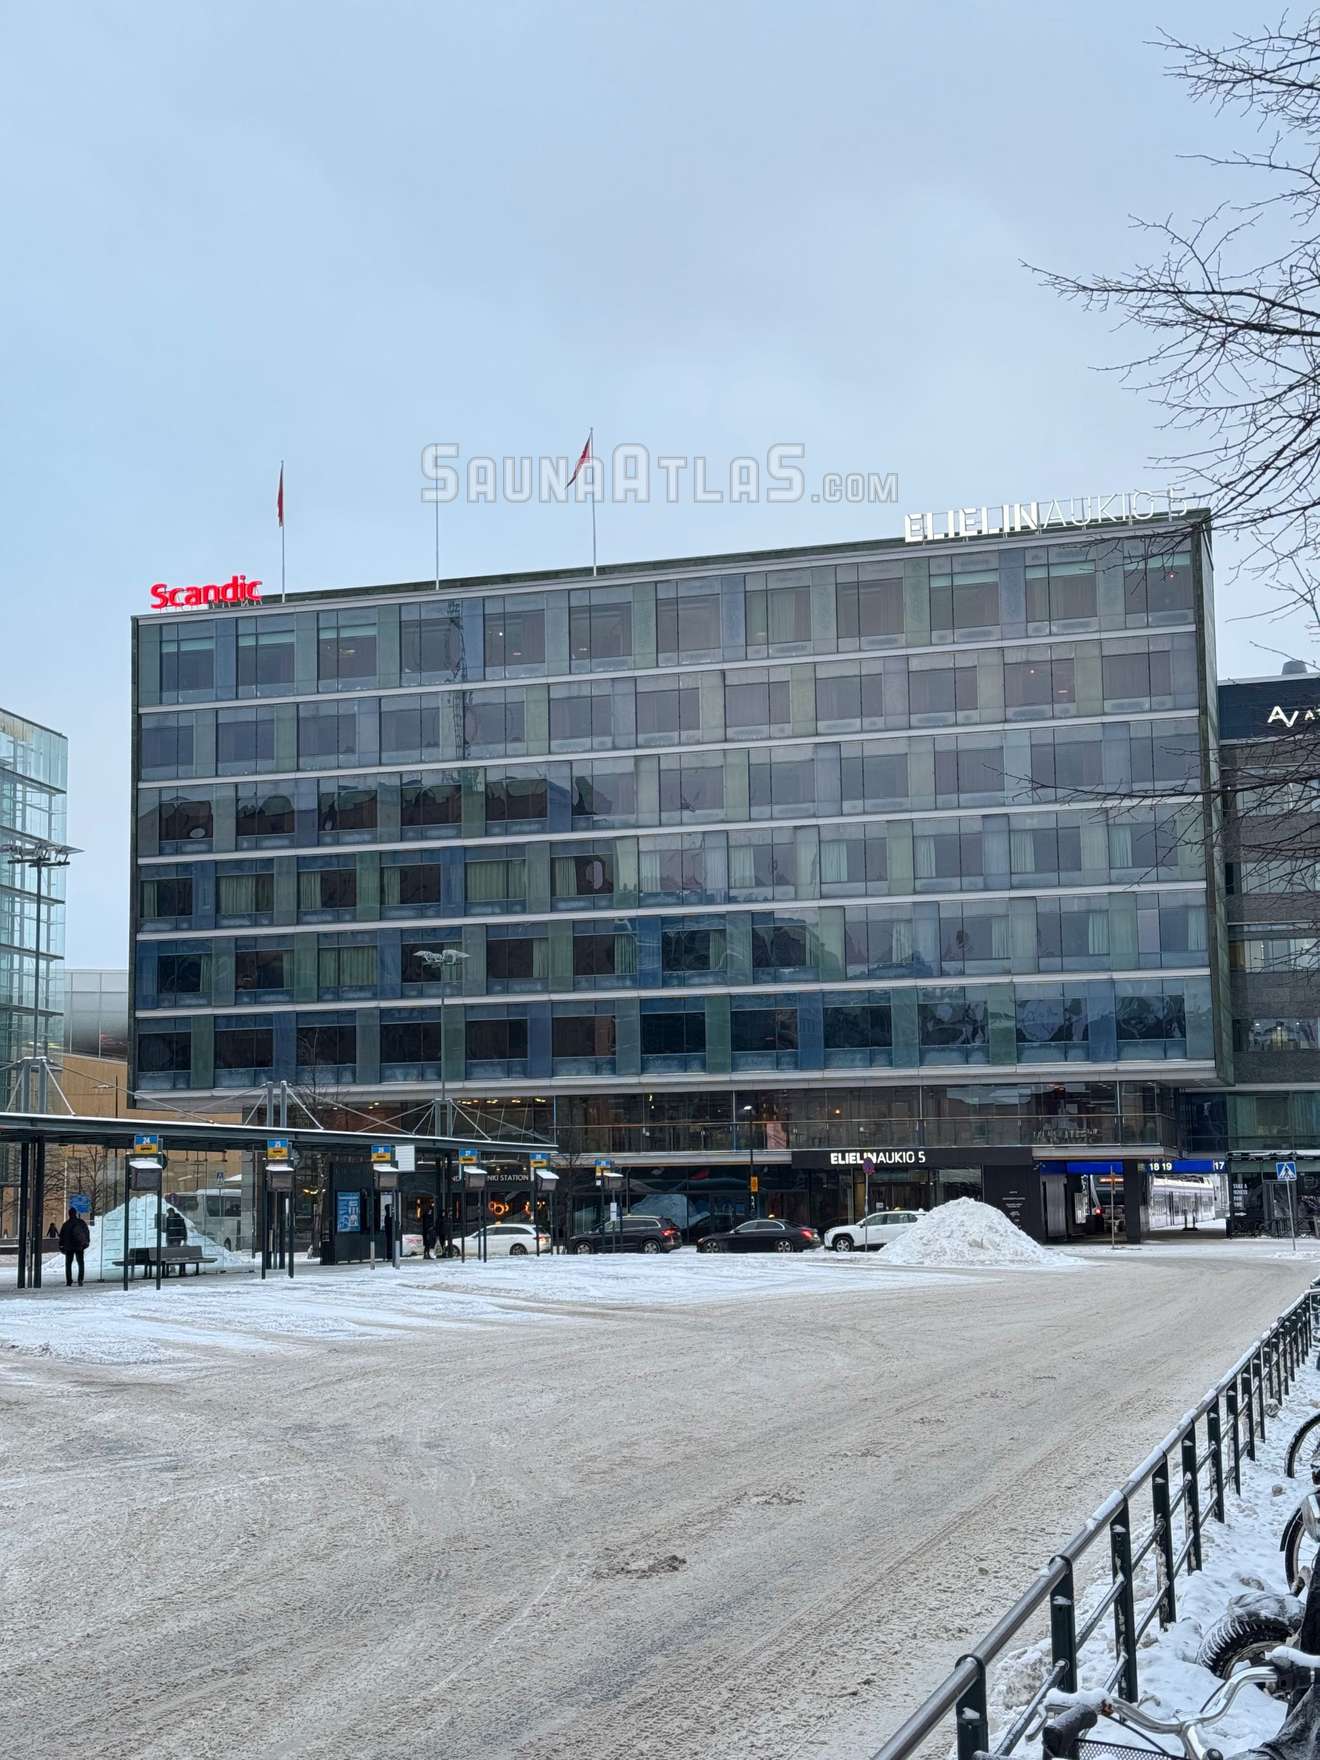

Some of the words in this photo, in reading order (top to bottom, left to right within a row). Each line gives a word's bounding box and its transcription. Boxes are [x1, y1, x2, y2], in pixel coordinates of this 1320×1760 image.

[904, 489, 1154, 543] ELIELINAUKIO
[150, 575, 263, 609] Scandic
[830, 1151, 915, 1164] ELIELINAUKIO
[918, 1151, 926, 1163] 5
[1149, 1162, 1160, 1171] 18
[1162, 1162, 1172, 1171] 19
[1214, 1161, 1225, 1170] 17
[499, 1174, 529, 1182] STATION
